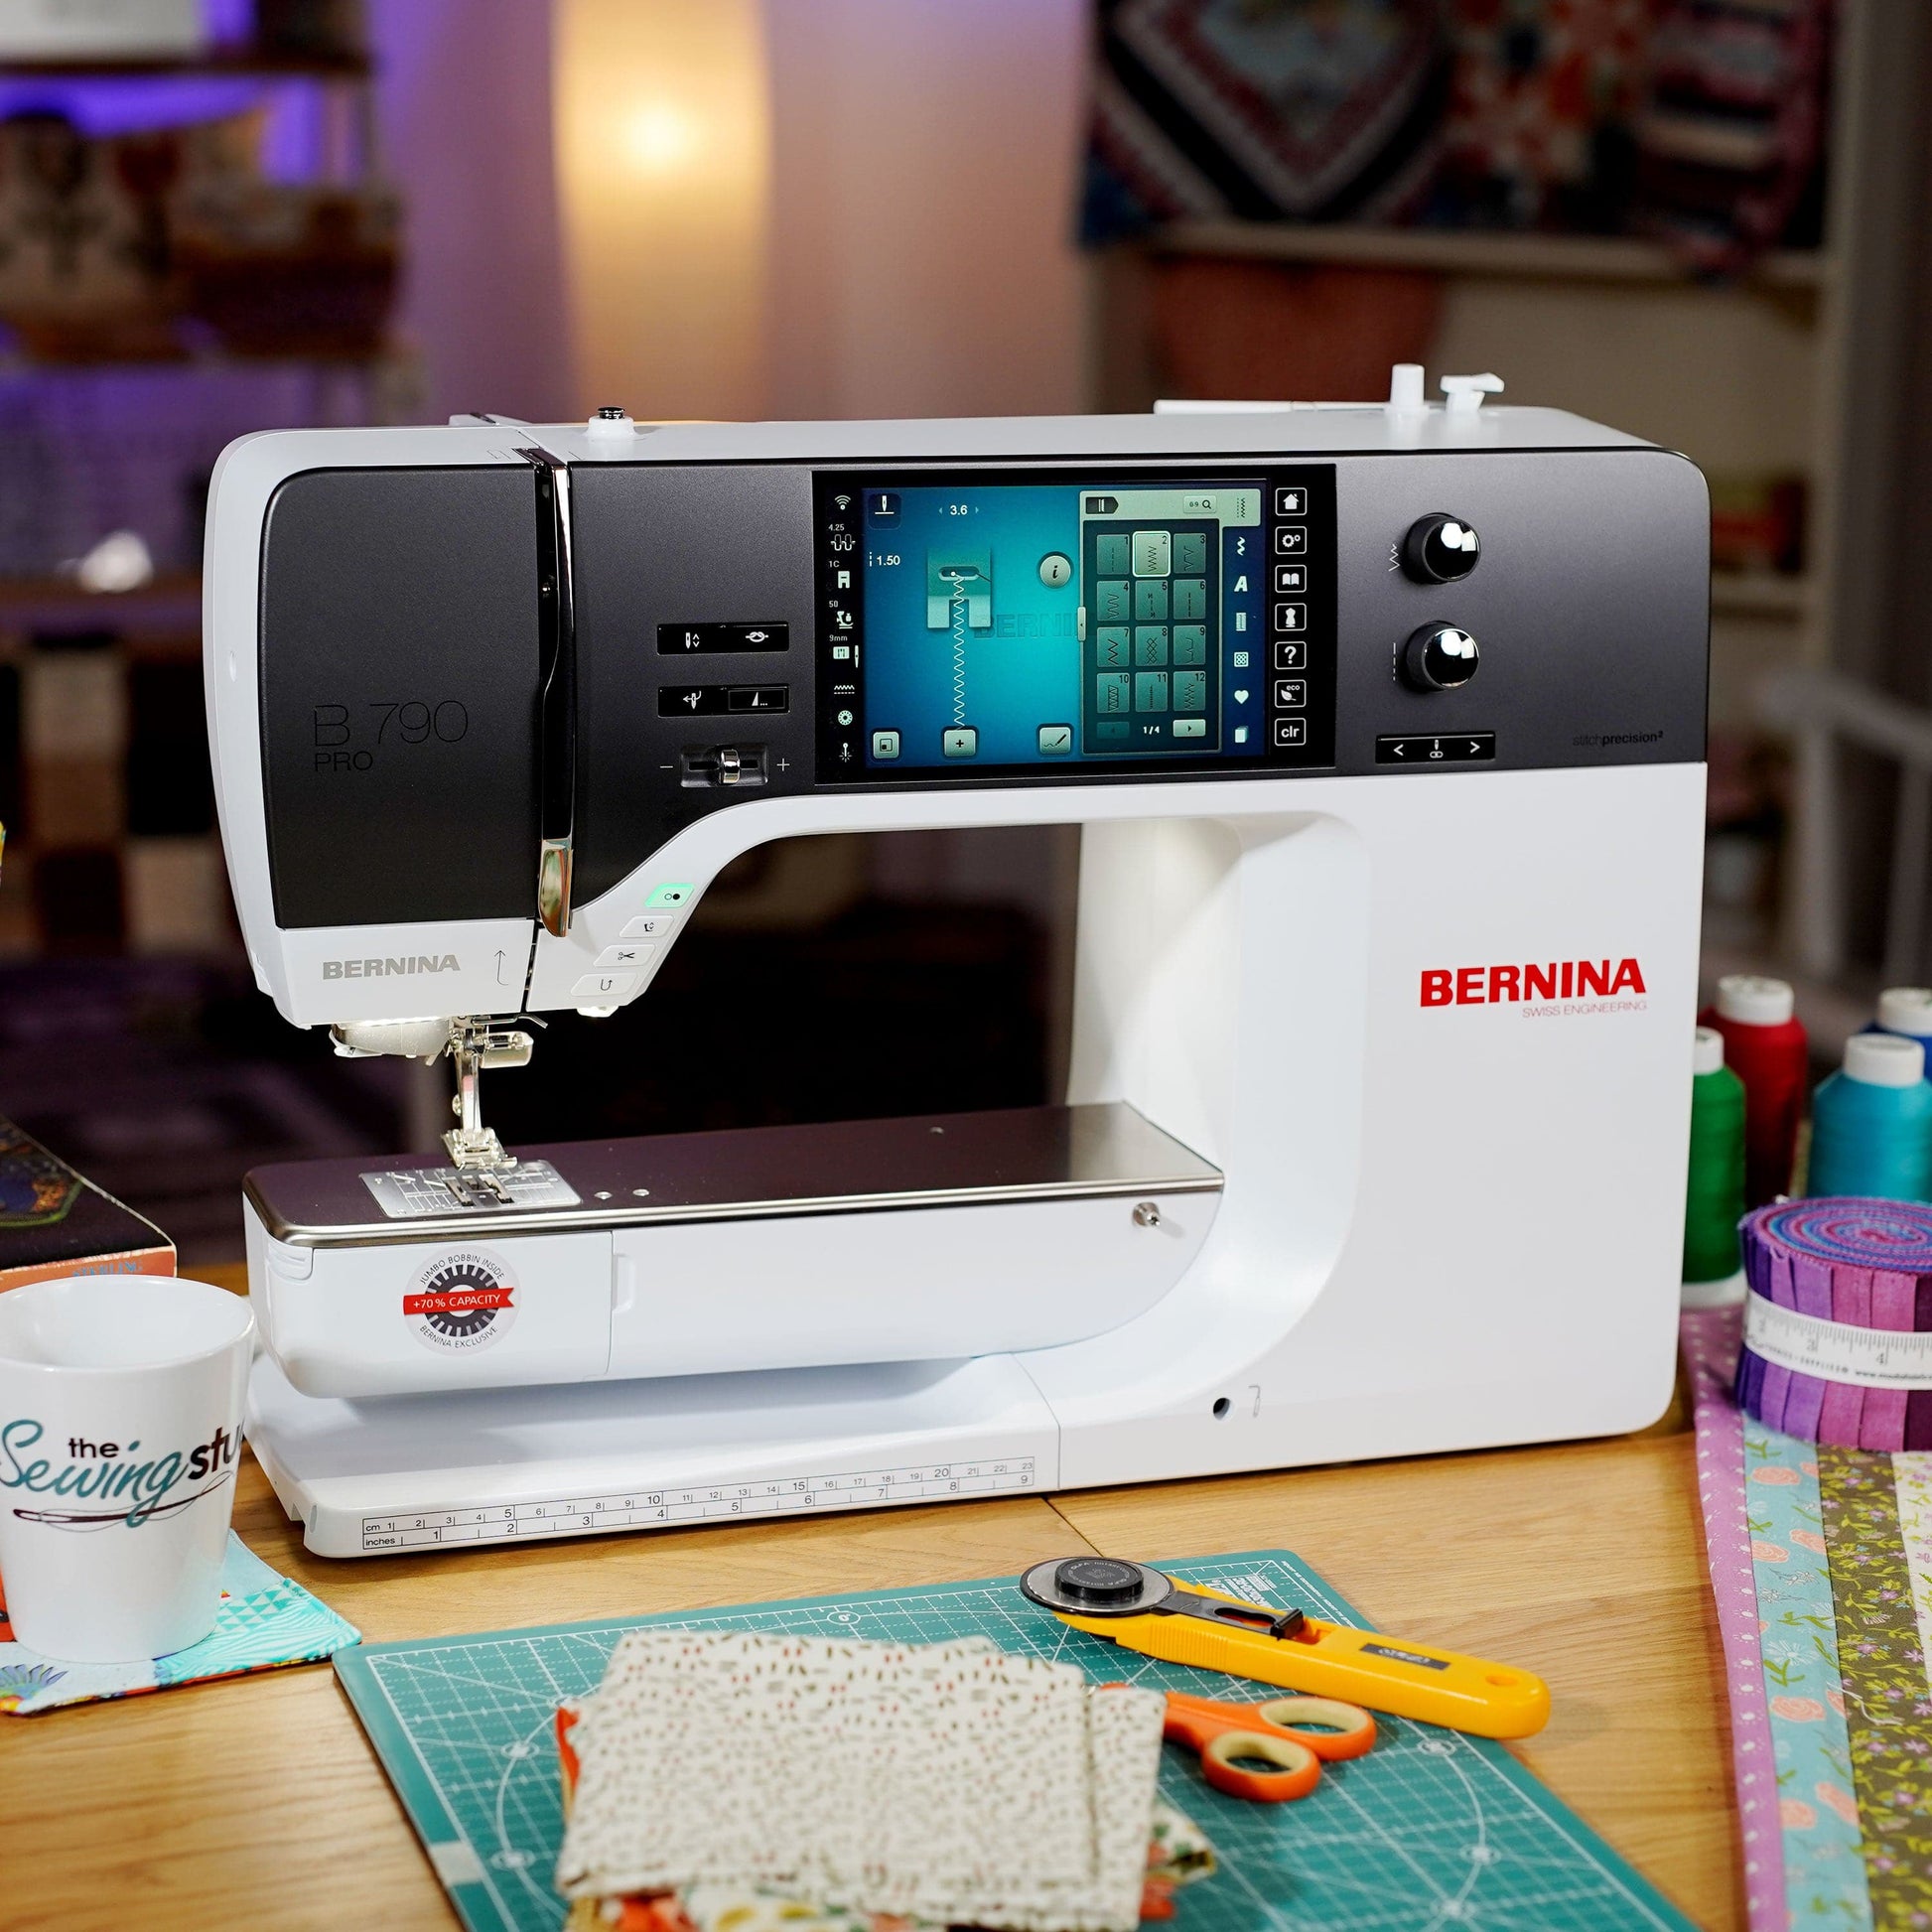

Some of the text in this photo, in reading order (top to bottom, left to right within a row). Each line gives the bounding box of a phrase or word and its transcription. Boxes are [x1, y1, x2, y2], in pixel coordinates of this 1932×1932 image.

[949, 504, 968, 515] 3.6
[1124, 536, 1129, 545] 1
[1162, 535, 1168, 545] 2
[1199, 535, 1205, 544] 3
[876, 555, 900, 566] 1.50
[1162, 582, 1168, 591] 5
[1199, 581, 1205, 590] 6
[1233, 575, 1248, 592] A
[974, 613, 1077, 638] BERNI
[1123, 628, 1129, 637] 7
[1162, 627, 1168, 636] 8
[1199, 627, 1205, 636] 9
[1119, 675, 1129, 684] 10
[314, 700, 469, 747] B 790
[1143, 725, 1160, 735] 1/4
[1281, 726, 1300, 739] clr
[314, 751, 374, 772] PRO
[322, 954, 462, 980] BERNINA
[1420, 958, 1647, 1008] BERNINA
[1522, 1000, 1648, 1019] SWISS ENGINEERING
[419, 1253, 505, 1285] JUMBO BOBBIN INSIDE
[413, 1294, 501, 1309] +70 % CAPACITY
[419, 1324, 498, 1349] BERNINA EXCLUSIVE
[69, 1438, 120, 1459] the
[0, 1416, 246, 1529] Sewing stu
[365, 1523, 381, 1532] cm
[416, 1519, 422, 1528] 2
[504, 1508, 512, 1519] 5
[535, 1507, 542, 1516] 6
[624, 1499, 631, 1508] 9
[647, 1495, 661, 1505] 10
[738, 1488, 748, 1497] 13
[766, 1485, 776, 1494] 14
[792, 1481, 806, 1491] 15
[824, 1480, 834, 1489] 16
[909, 1472, 919, 1481] 19
[934, 1467, 949, 1478] 20
[1022, 1461, 1034, 1470] 23
[365, 1475, 1029, 1547] inches 1 2 3 4 5 6 7 8 9
